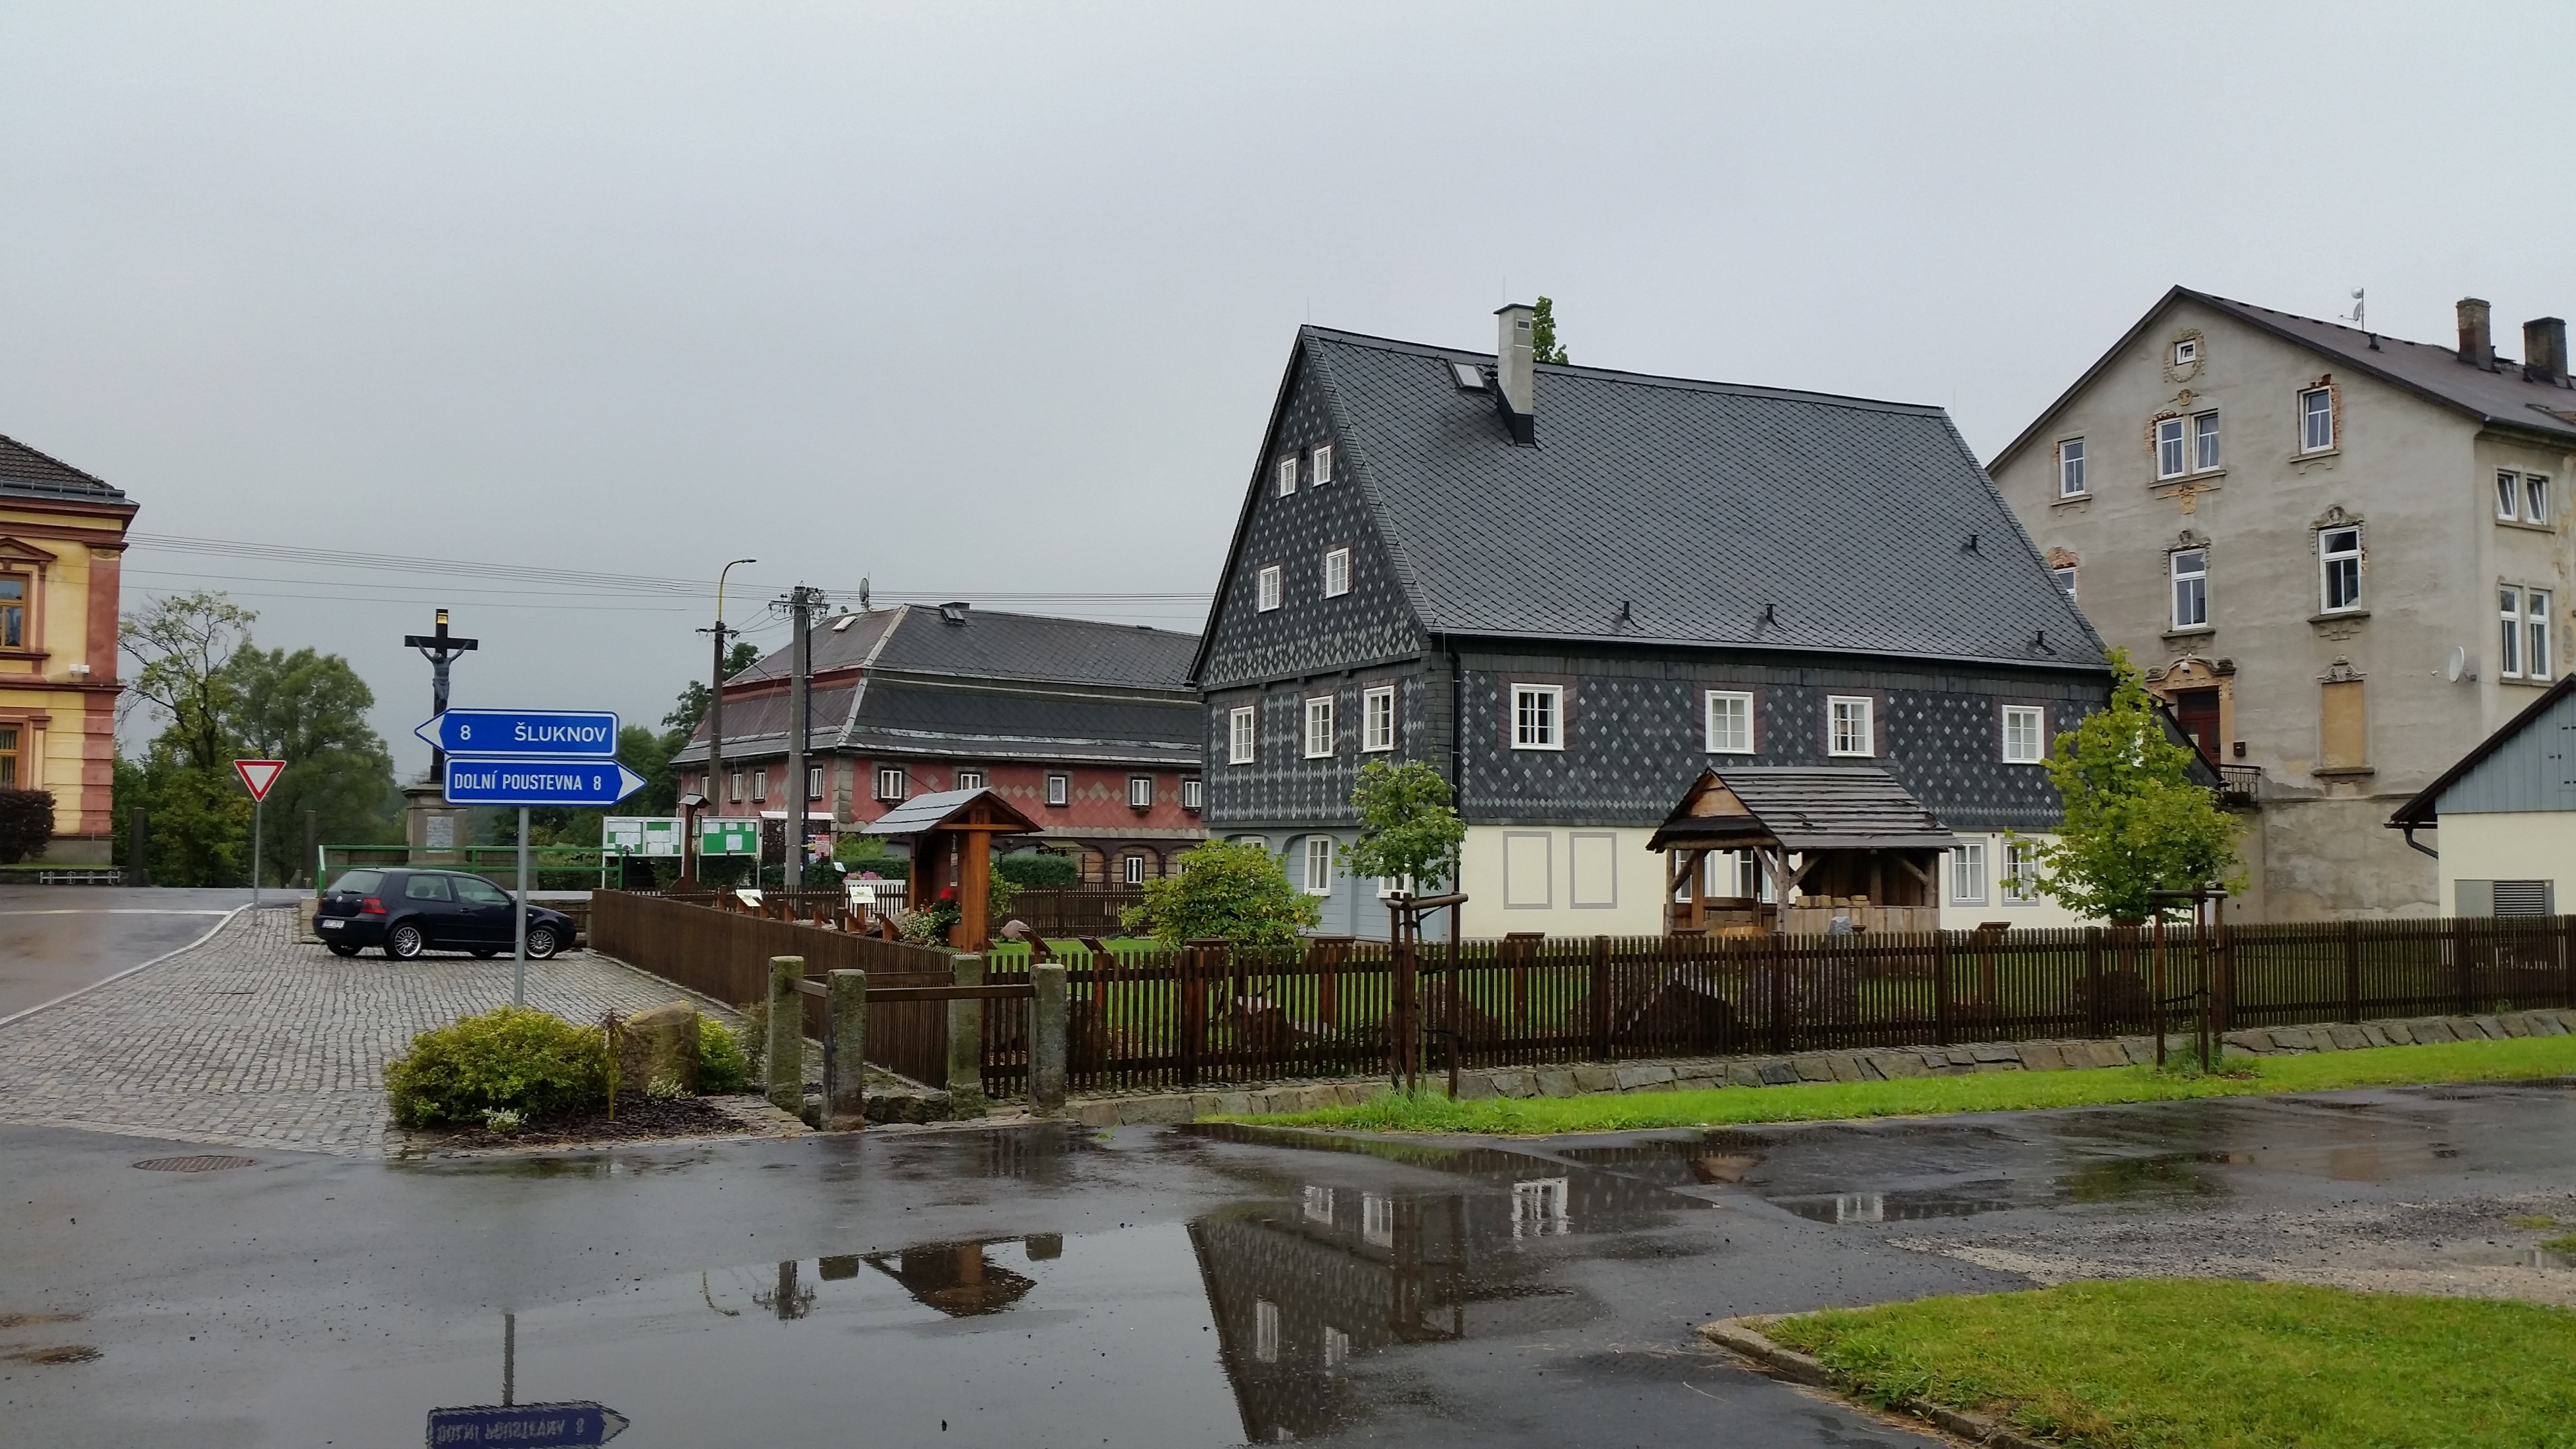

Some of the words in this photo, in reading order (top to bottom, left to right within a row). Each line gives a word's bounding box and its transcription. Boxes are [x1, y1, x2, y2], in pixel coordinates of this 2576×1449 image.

[460, 724, 471, 741] 8
[514, 721, 607, 743] ŠLUKNOV
[454, 770, 498, 790] DOLNÍ
[502, 774, 582, 791] POUSTEVNA
[593, 775, 601, 791] 8
